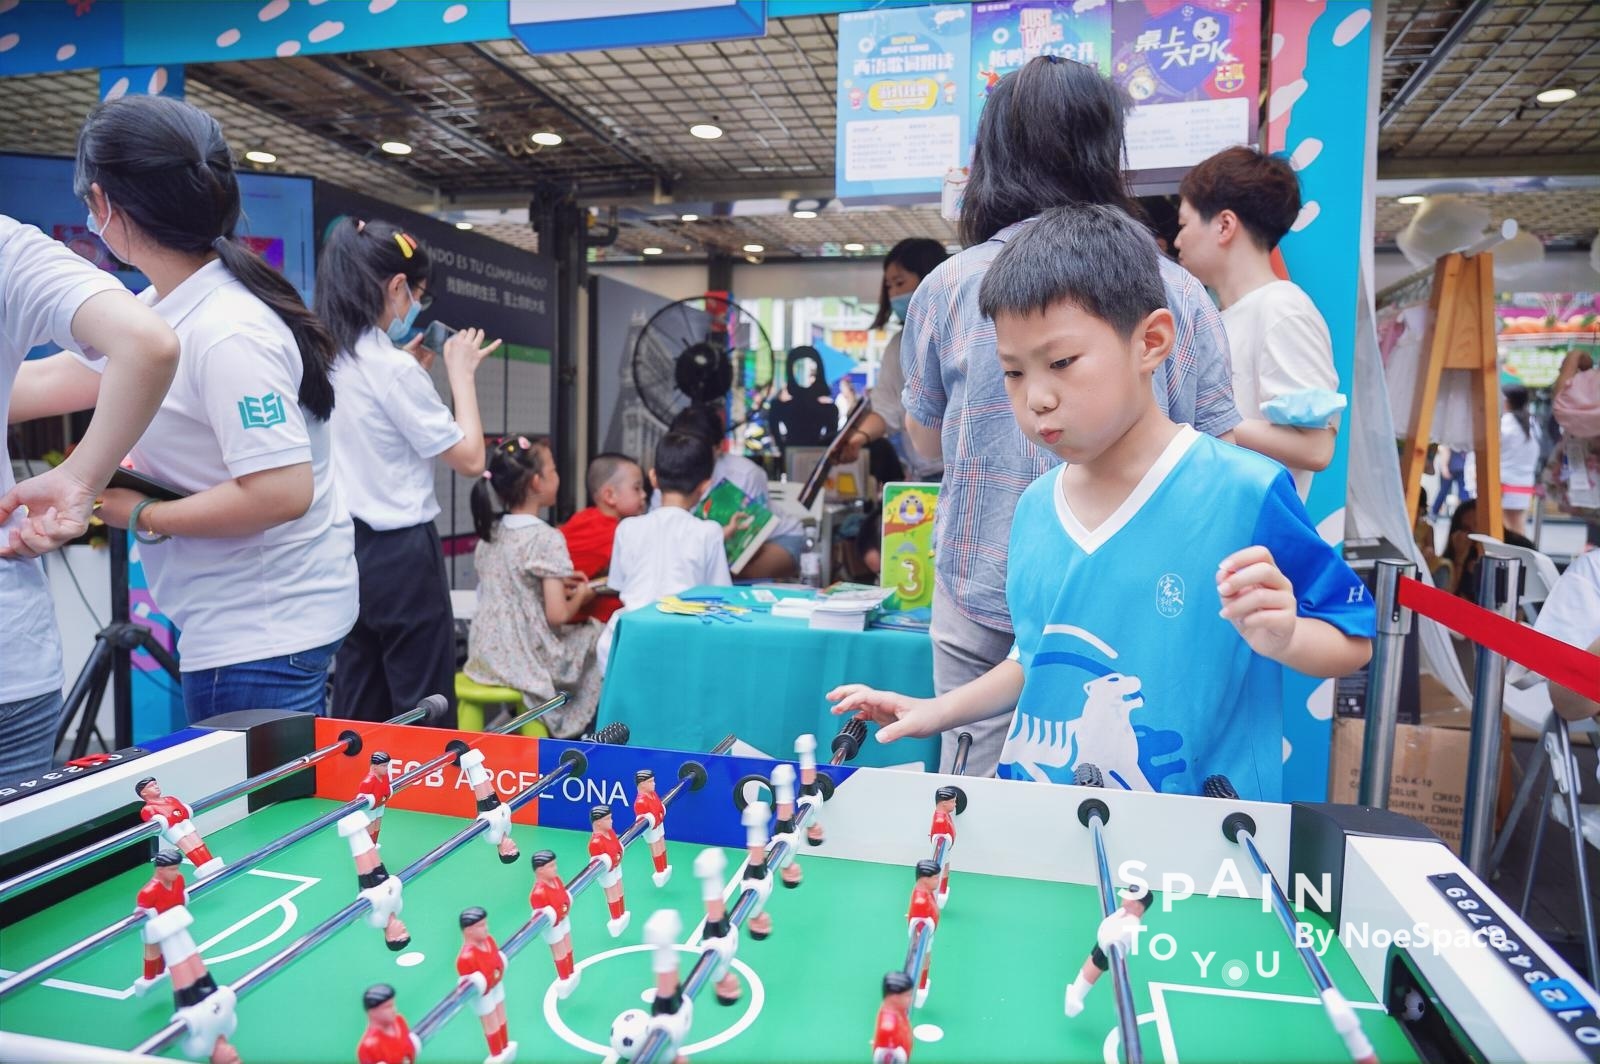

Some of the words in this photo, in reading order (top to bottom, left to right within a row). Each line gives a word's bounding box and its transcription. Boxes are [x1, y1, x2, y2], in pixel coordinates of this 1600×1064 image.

[1135, 26, 1185, 53] 桌上
[1160, 38, 1238, 70] 大PK
[456, 254, 468, 270] ES
[469, 258, 484, 275] TU
[1346, 584, 1364, 604] H
[1457, 899, 1480, 910] 8
[1467, 912, 1491, 924] 7
[1508, 954, 1533, 968] 4
[1540, 988, 1569, 1003] 2
[1557, 1010, 1584, 1023] 1
